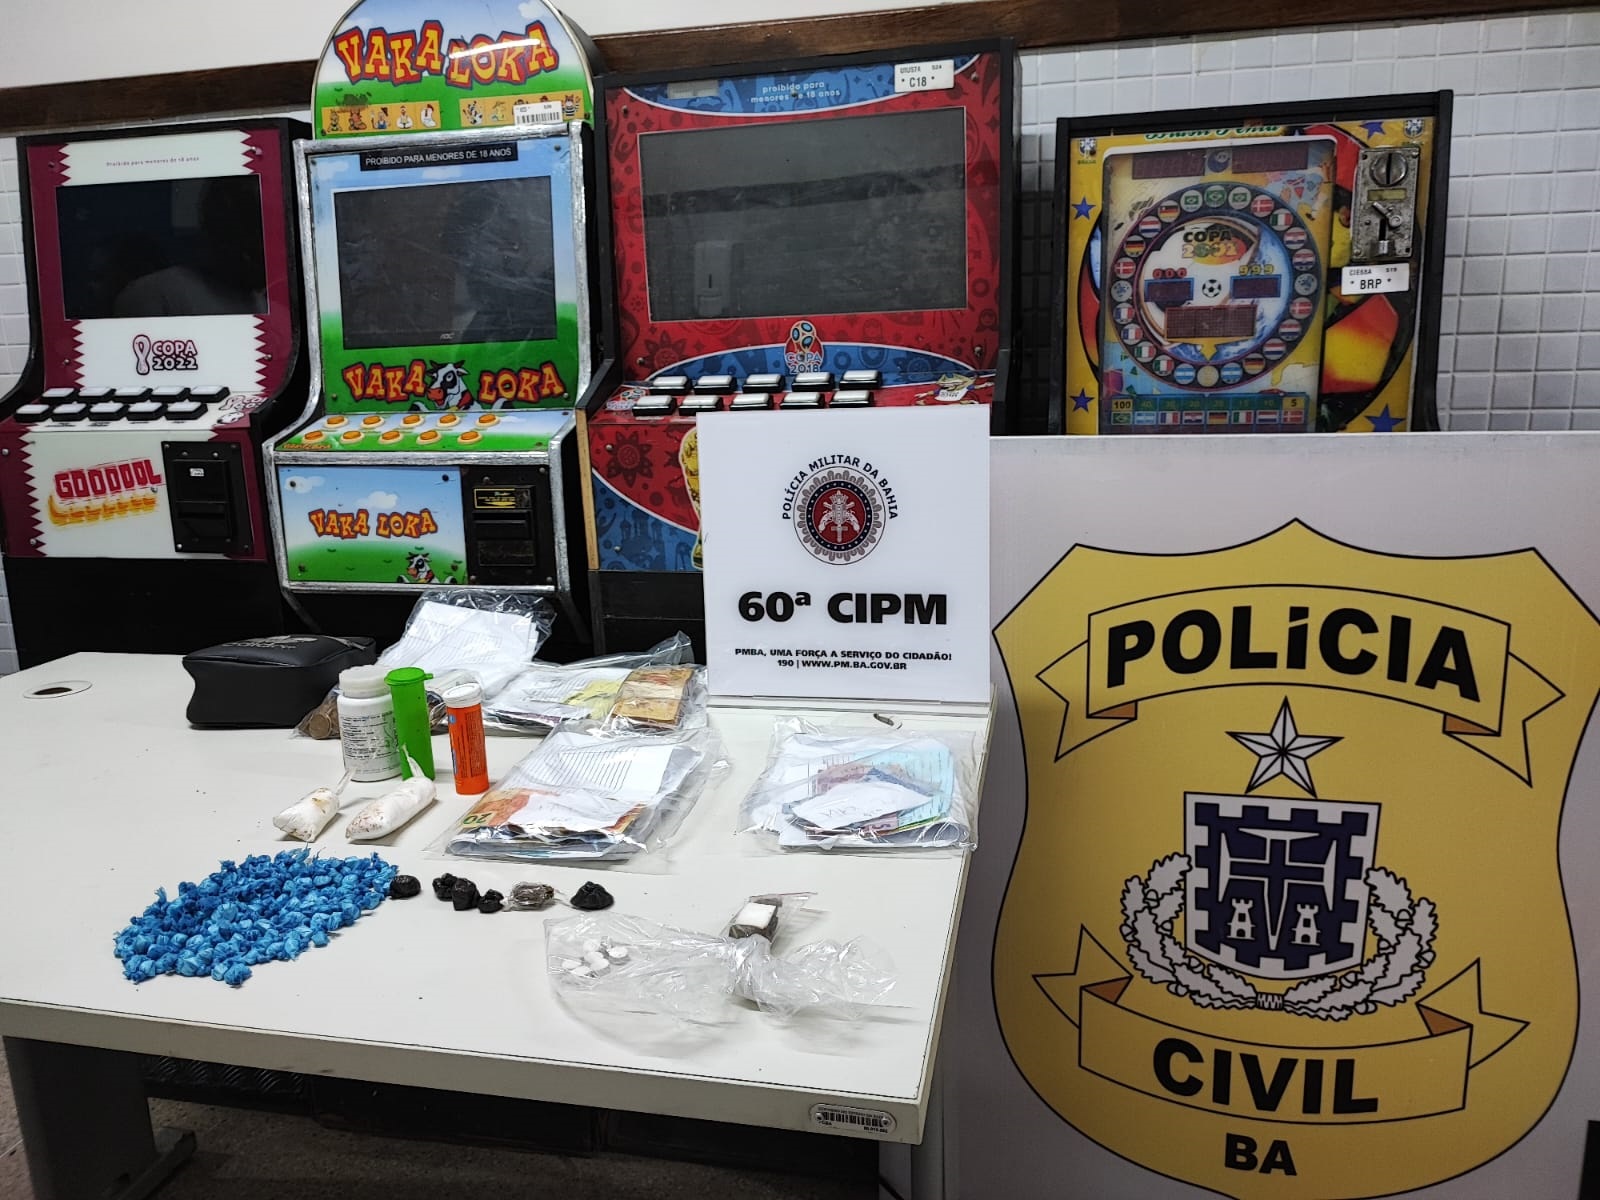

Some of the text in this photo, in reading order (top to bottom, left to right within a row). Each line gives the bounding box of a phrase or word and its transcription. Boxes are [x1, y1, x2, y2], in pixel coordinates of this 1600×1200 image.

[334, 20, 560, 90] VAKA LOKA
[762, 81, 824, 94] proibido para
[909, 76, 927, 88] C18
[750, 94, 790, 103] menores
[818, 89, 840, 97] anos
[365, 148, 512, 166] PROIBIDO PARA MENORES DE 18 ANOS
[1183, 230, 1232, 243] COPA
[152, 340, 198, 356] COPA
[152, 356, 198, 370] 2022
[786, 352, 822, 362] COPA
[790, 363, 820, 374] 2018
[342, 359, 564, 404] VAKA LOKA
[1114, 400, 1132, 410] 100
[782, 454, 898, 520] POLÍCIA MILITAR DA BAHIA
[308, 508, 438, 539] VAKA LOKA
[738, 591, 948, 625] 60ª CIPM
[734, 648, 766, 657] PMBA,
[795, 649, 828, 660] FORÇA
[830, 650, 838, 658] A
[840, 650, 882, 660] SERVIÇO
[902, 651, 952, 661] CIDADÃO!
[801, 660, 908, 670] WWW.PM.BA.GOV.BR
[1152, 1038, 1380, 1114] CIVIL
[1224, 1132, 1298, 1176] BA
